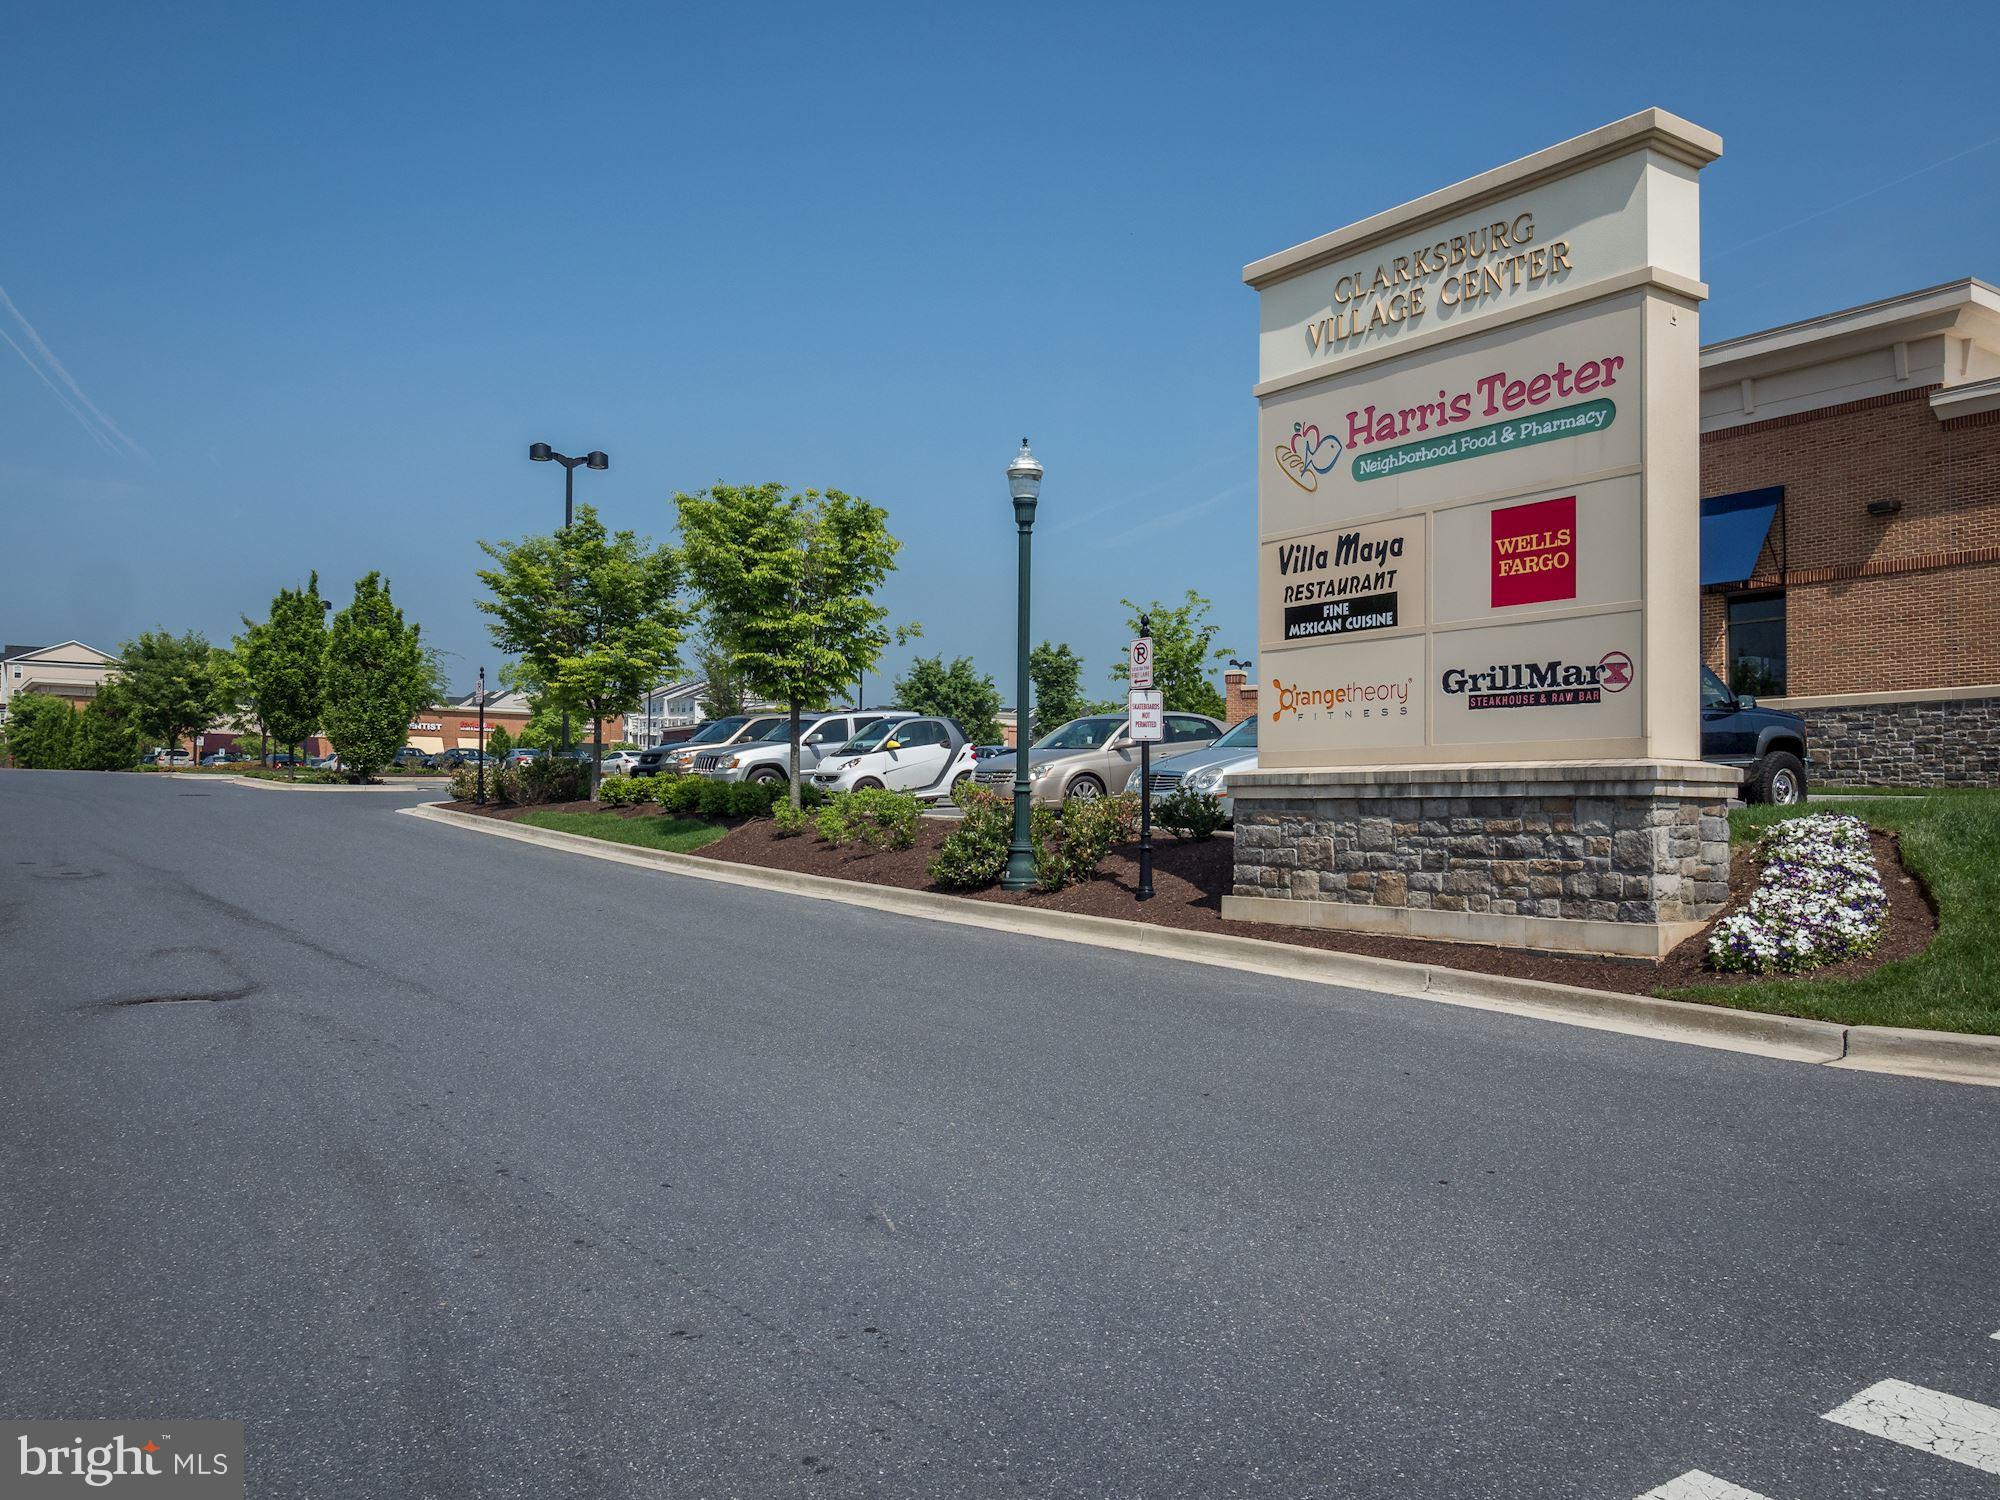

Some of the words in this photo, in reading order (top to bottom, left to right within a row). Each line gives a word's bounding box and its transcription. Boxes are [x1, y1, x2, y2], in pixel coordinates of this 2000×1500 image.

[1334, 212, 1535, 304] CLARKSBURG
[1308, 287, 1426, 349] VILLAGE
[1440, 240, 1573, 306] CENTER
[1345, 390, 1471, 450] Harris
[1477, 355, 1624, 416] Teeter
[1359, 440, 1457, 475] Neighborhood
[1461, 430, 1498, 453] Food
[1500, 423, 1517, 443] &
[1520, 408, 1607, 439] Pharmacy
[1279, 544, 1328, 575] Villa
[1334, 532, 1404, 568] Maya
[1495, 529, 1571, 555] WELLS
[1499, 551, 1570, 576] FARGO
[1284, 570, 1397, 603] RESTAURANT
[1323, 602, 1349, 618] FINE
[1289, 618, 1341, 637] MEXICAN
[1345, 611, 1393, 630] CUISINE
[1470, 693, 1535, 707] STEAKHOUSE
[1539, 693, 1547, 703] &
[1551, 692, 1574, 703] RAW
[1579, 691, 1600, 701] BAR
[407, 722, 442, 731] ENTIST
[1298, 707, 1407, 721] FITNESS
